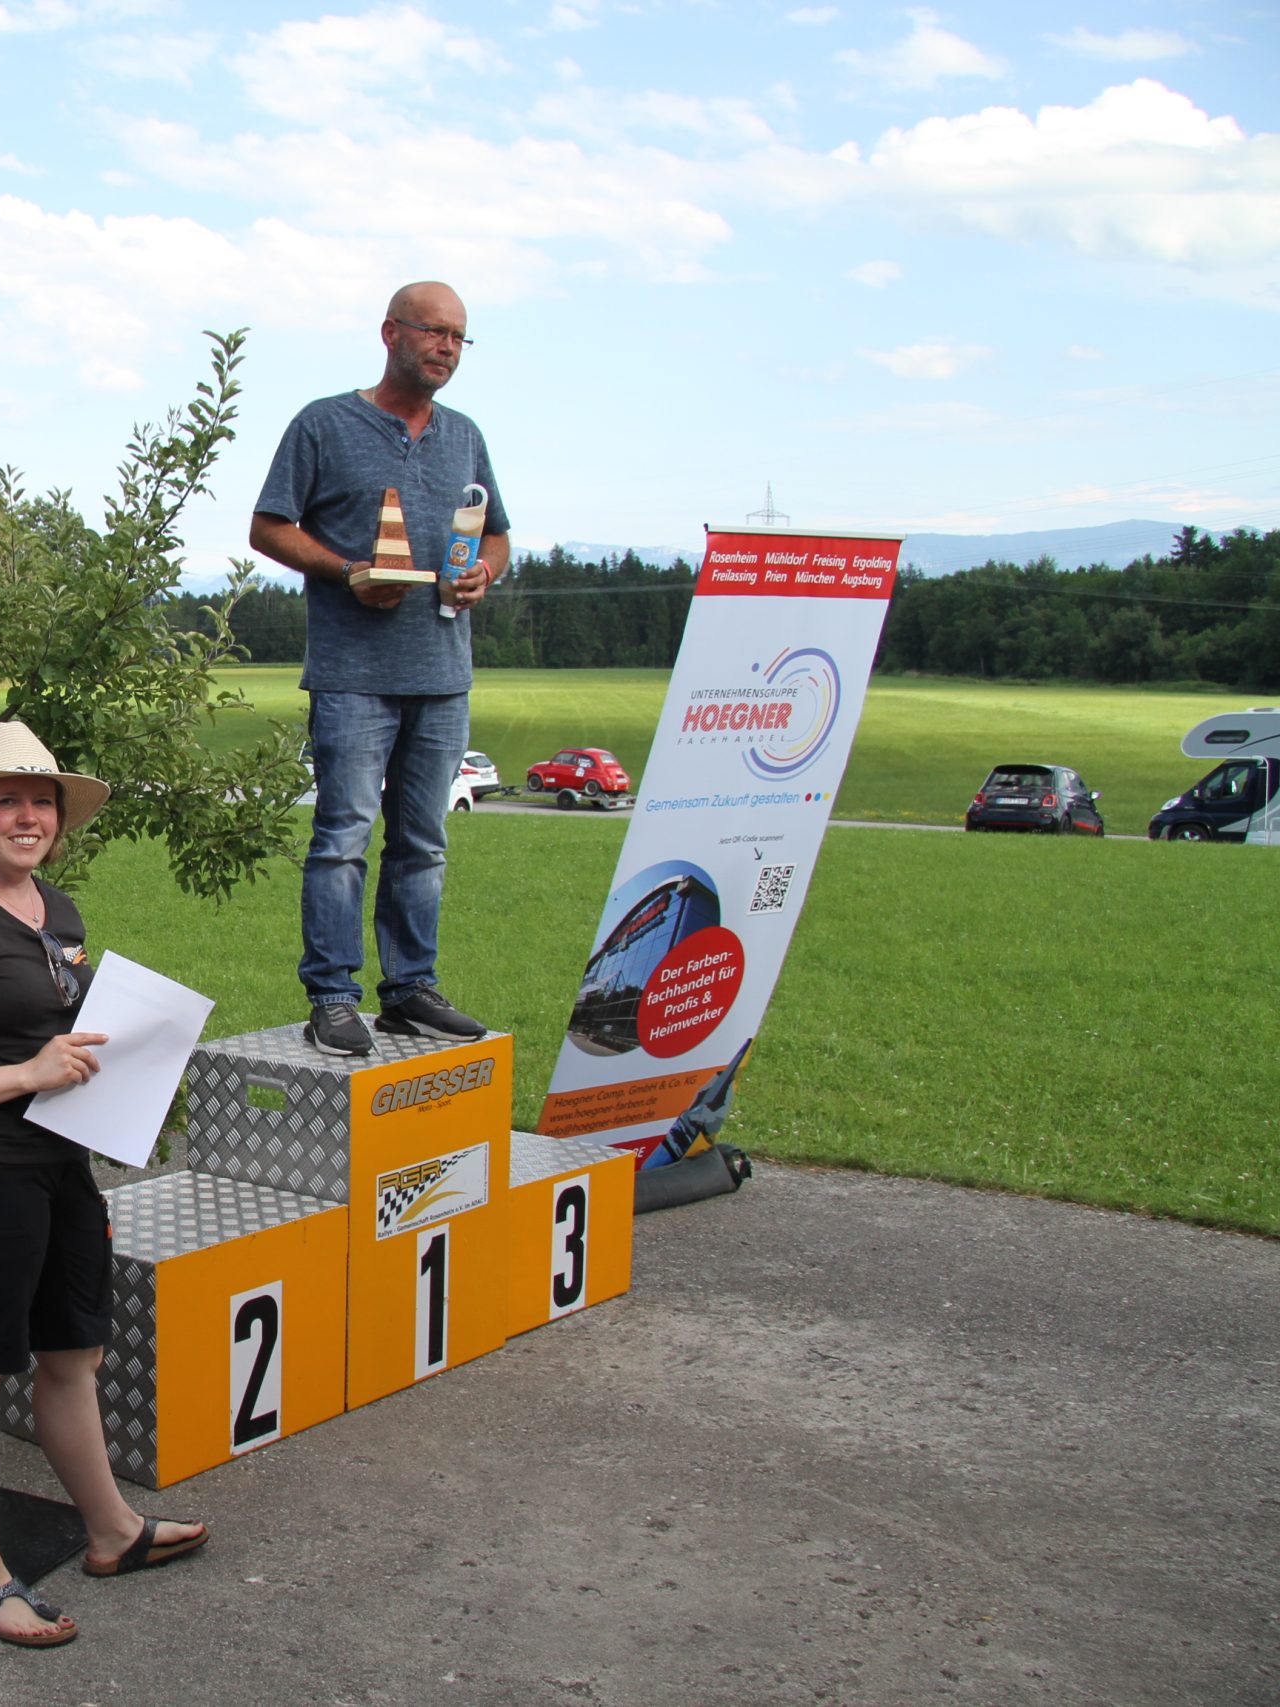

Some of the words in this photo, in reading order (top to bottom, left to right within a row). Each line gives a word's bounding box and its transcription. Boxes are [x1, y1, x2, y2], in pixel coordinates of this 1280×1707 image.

[709, 550, 758, 565] Rosenheim
[764, 551, 809, 566] Mühldorf
[812, 553, 847, 570] Freising
[852, 555, 892, 573] Ergolding
[711, 569, 758, 586] Freilassing
[764, 570, 788, 583] Prien
[794, 571, 836, 585] München
[840, 573, 883, 588] Augsburg
[690, 687, 799, 700] UNTERNEHMENSGRUPPE
[681, 702, 793, 733] HOEGNER
[677, 734, 786, 745] FACHHANDEL
[645, 796, 710, 812] Gemeinsam
[711, 793, 750, 808] Zukunft
[750, 791, 800, 807] gestalten
[660, 966, 684, 983] Der
[686, 951, 734, 974] Farben-
[646, 970, 716, 1006] fachhandel
[718, 966, 737, 981] für
[663, 996, 699, 1018] Profis
[701, 990, 713, 1004] &
[649, 1006, 724, 1041] Heimwerker
[370, 1057, 496, 1117] GRIESSER
[553, 1094, 597, 1109] Hoegner
[628, 1081, 657, 1095] GmbH
[658, 1081, 666, 1090] &
[668, 1078, 681, 1089] Co.
[684, 1074, 698, 1085] KG
[378, 1159, 442, 1198] RGR
[552, 1183, 586, 1308] 3
[420, 1232, 446, 1367] 1
[233, 1294, 279, 1449] 2
